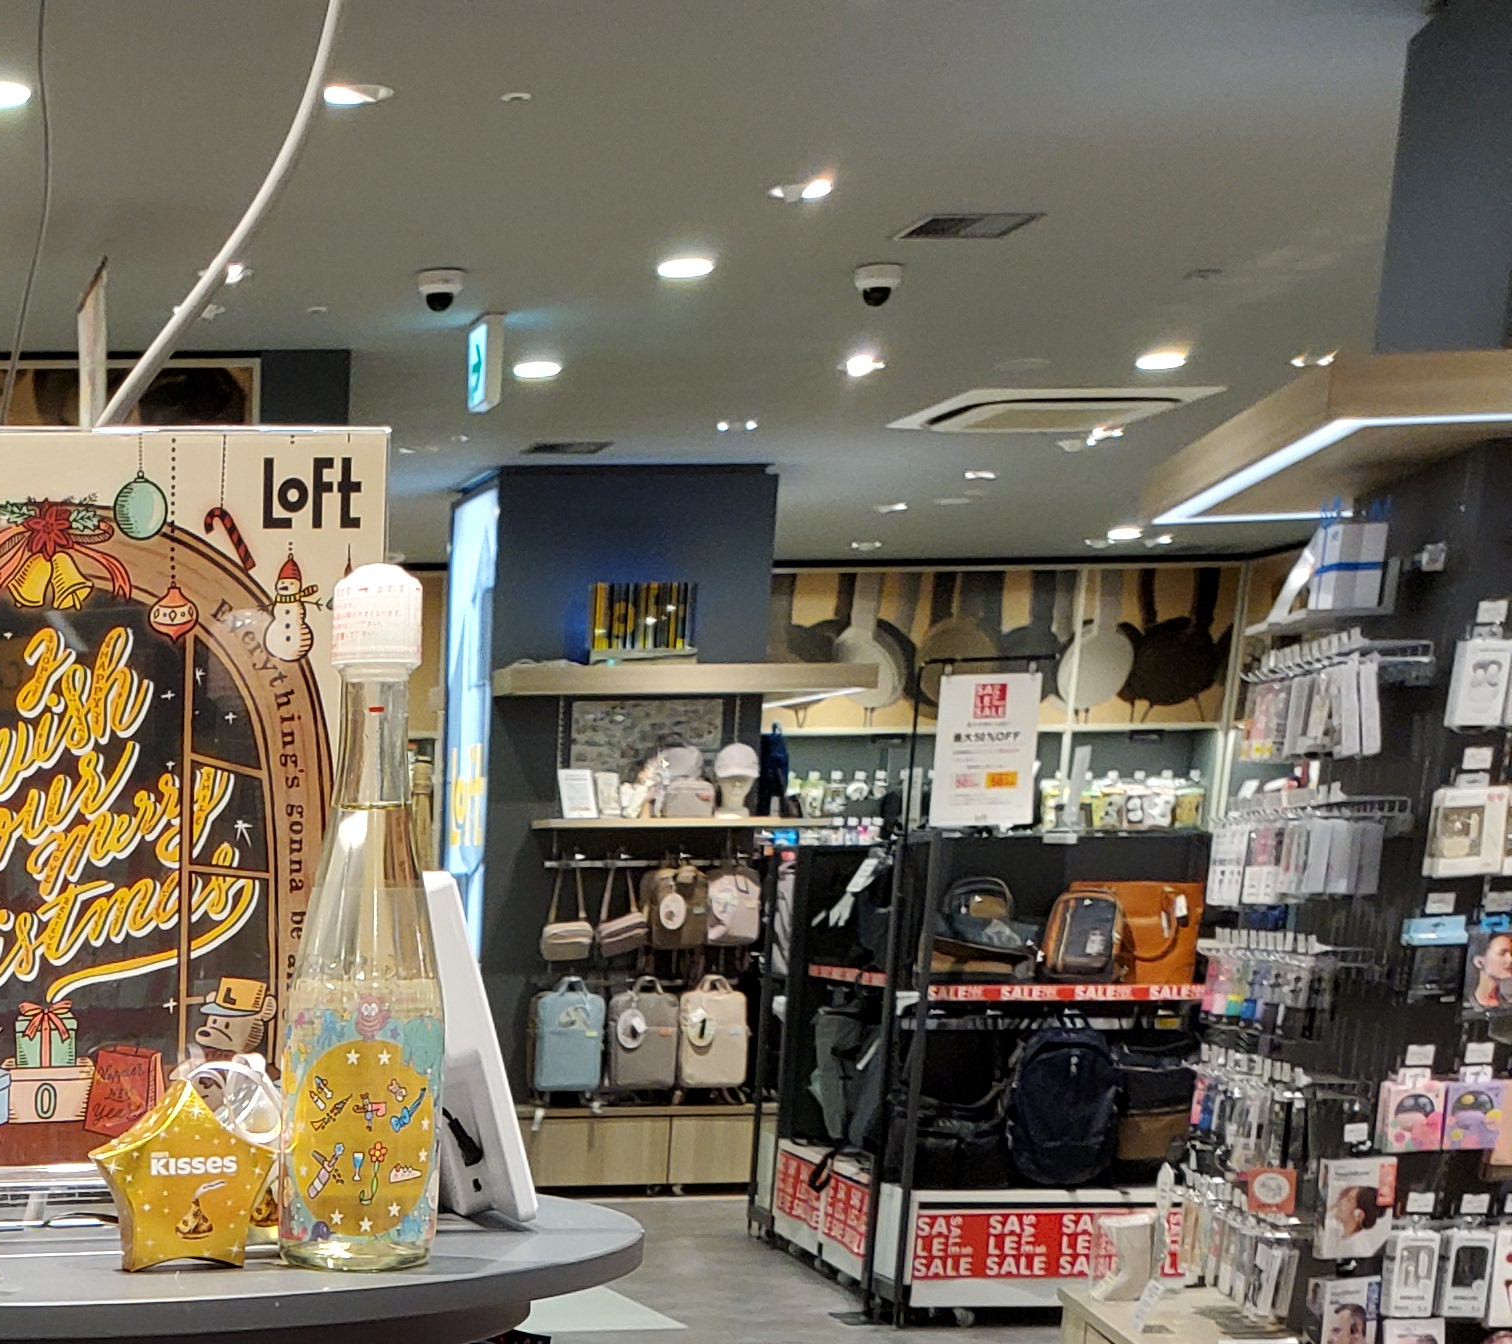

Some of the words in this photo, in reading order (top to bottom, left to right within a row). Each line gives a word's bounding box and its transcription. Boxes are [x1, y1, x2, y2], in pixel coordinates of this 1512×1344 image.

[27, 768, 235, 898] Merry
[285, 800, 306, 894] gonna
[38, 1082, 55, 1119] 0
[913, 1256, 973, 1277] SALE
[985, 1256, 1047, 1276] SALE
